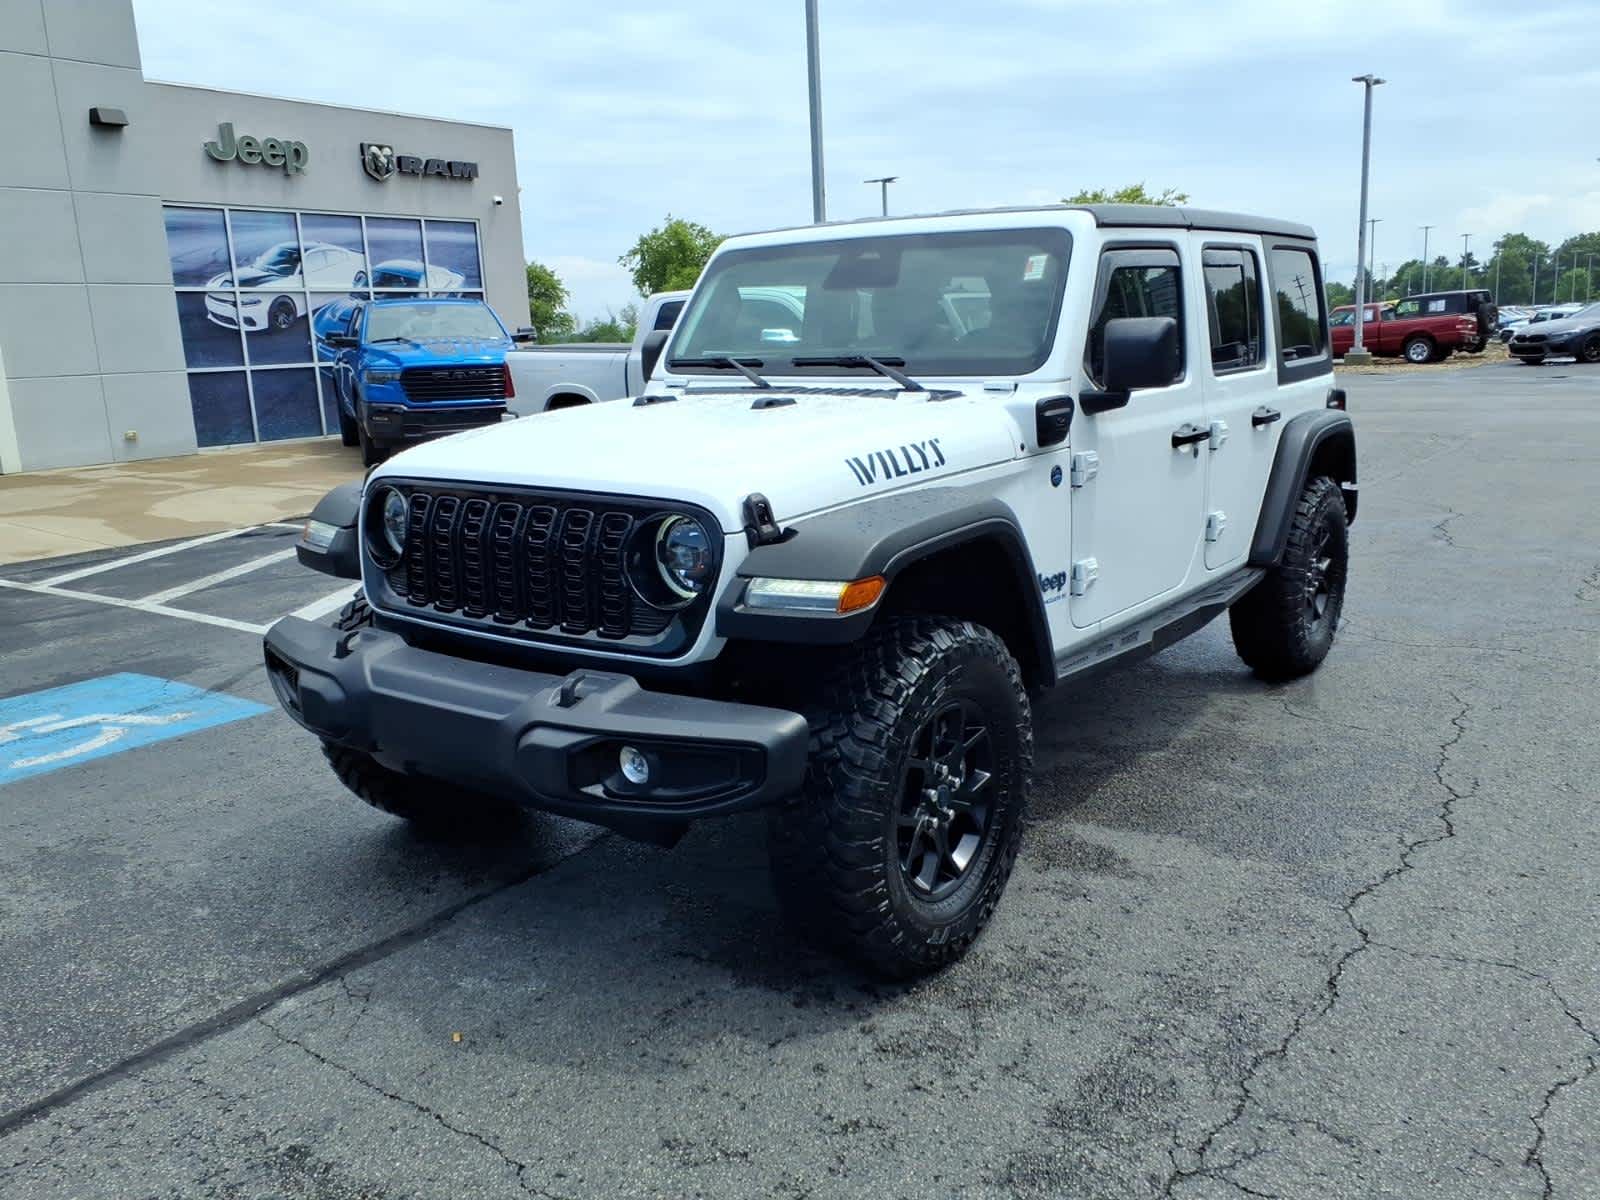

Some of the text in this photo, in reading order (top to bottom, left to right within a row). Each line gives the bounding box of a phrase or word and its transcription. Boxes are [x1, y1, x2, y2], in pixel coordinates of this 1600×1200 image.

[204, 121, 309, 176] Jeep
[396, 155, 478, 179] RAM
[844, 437, 946, 486] WILLYS
